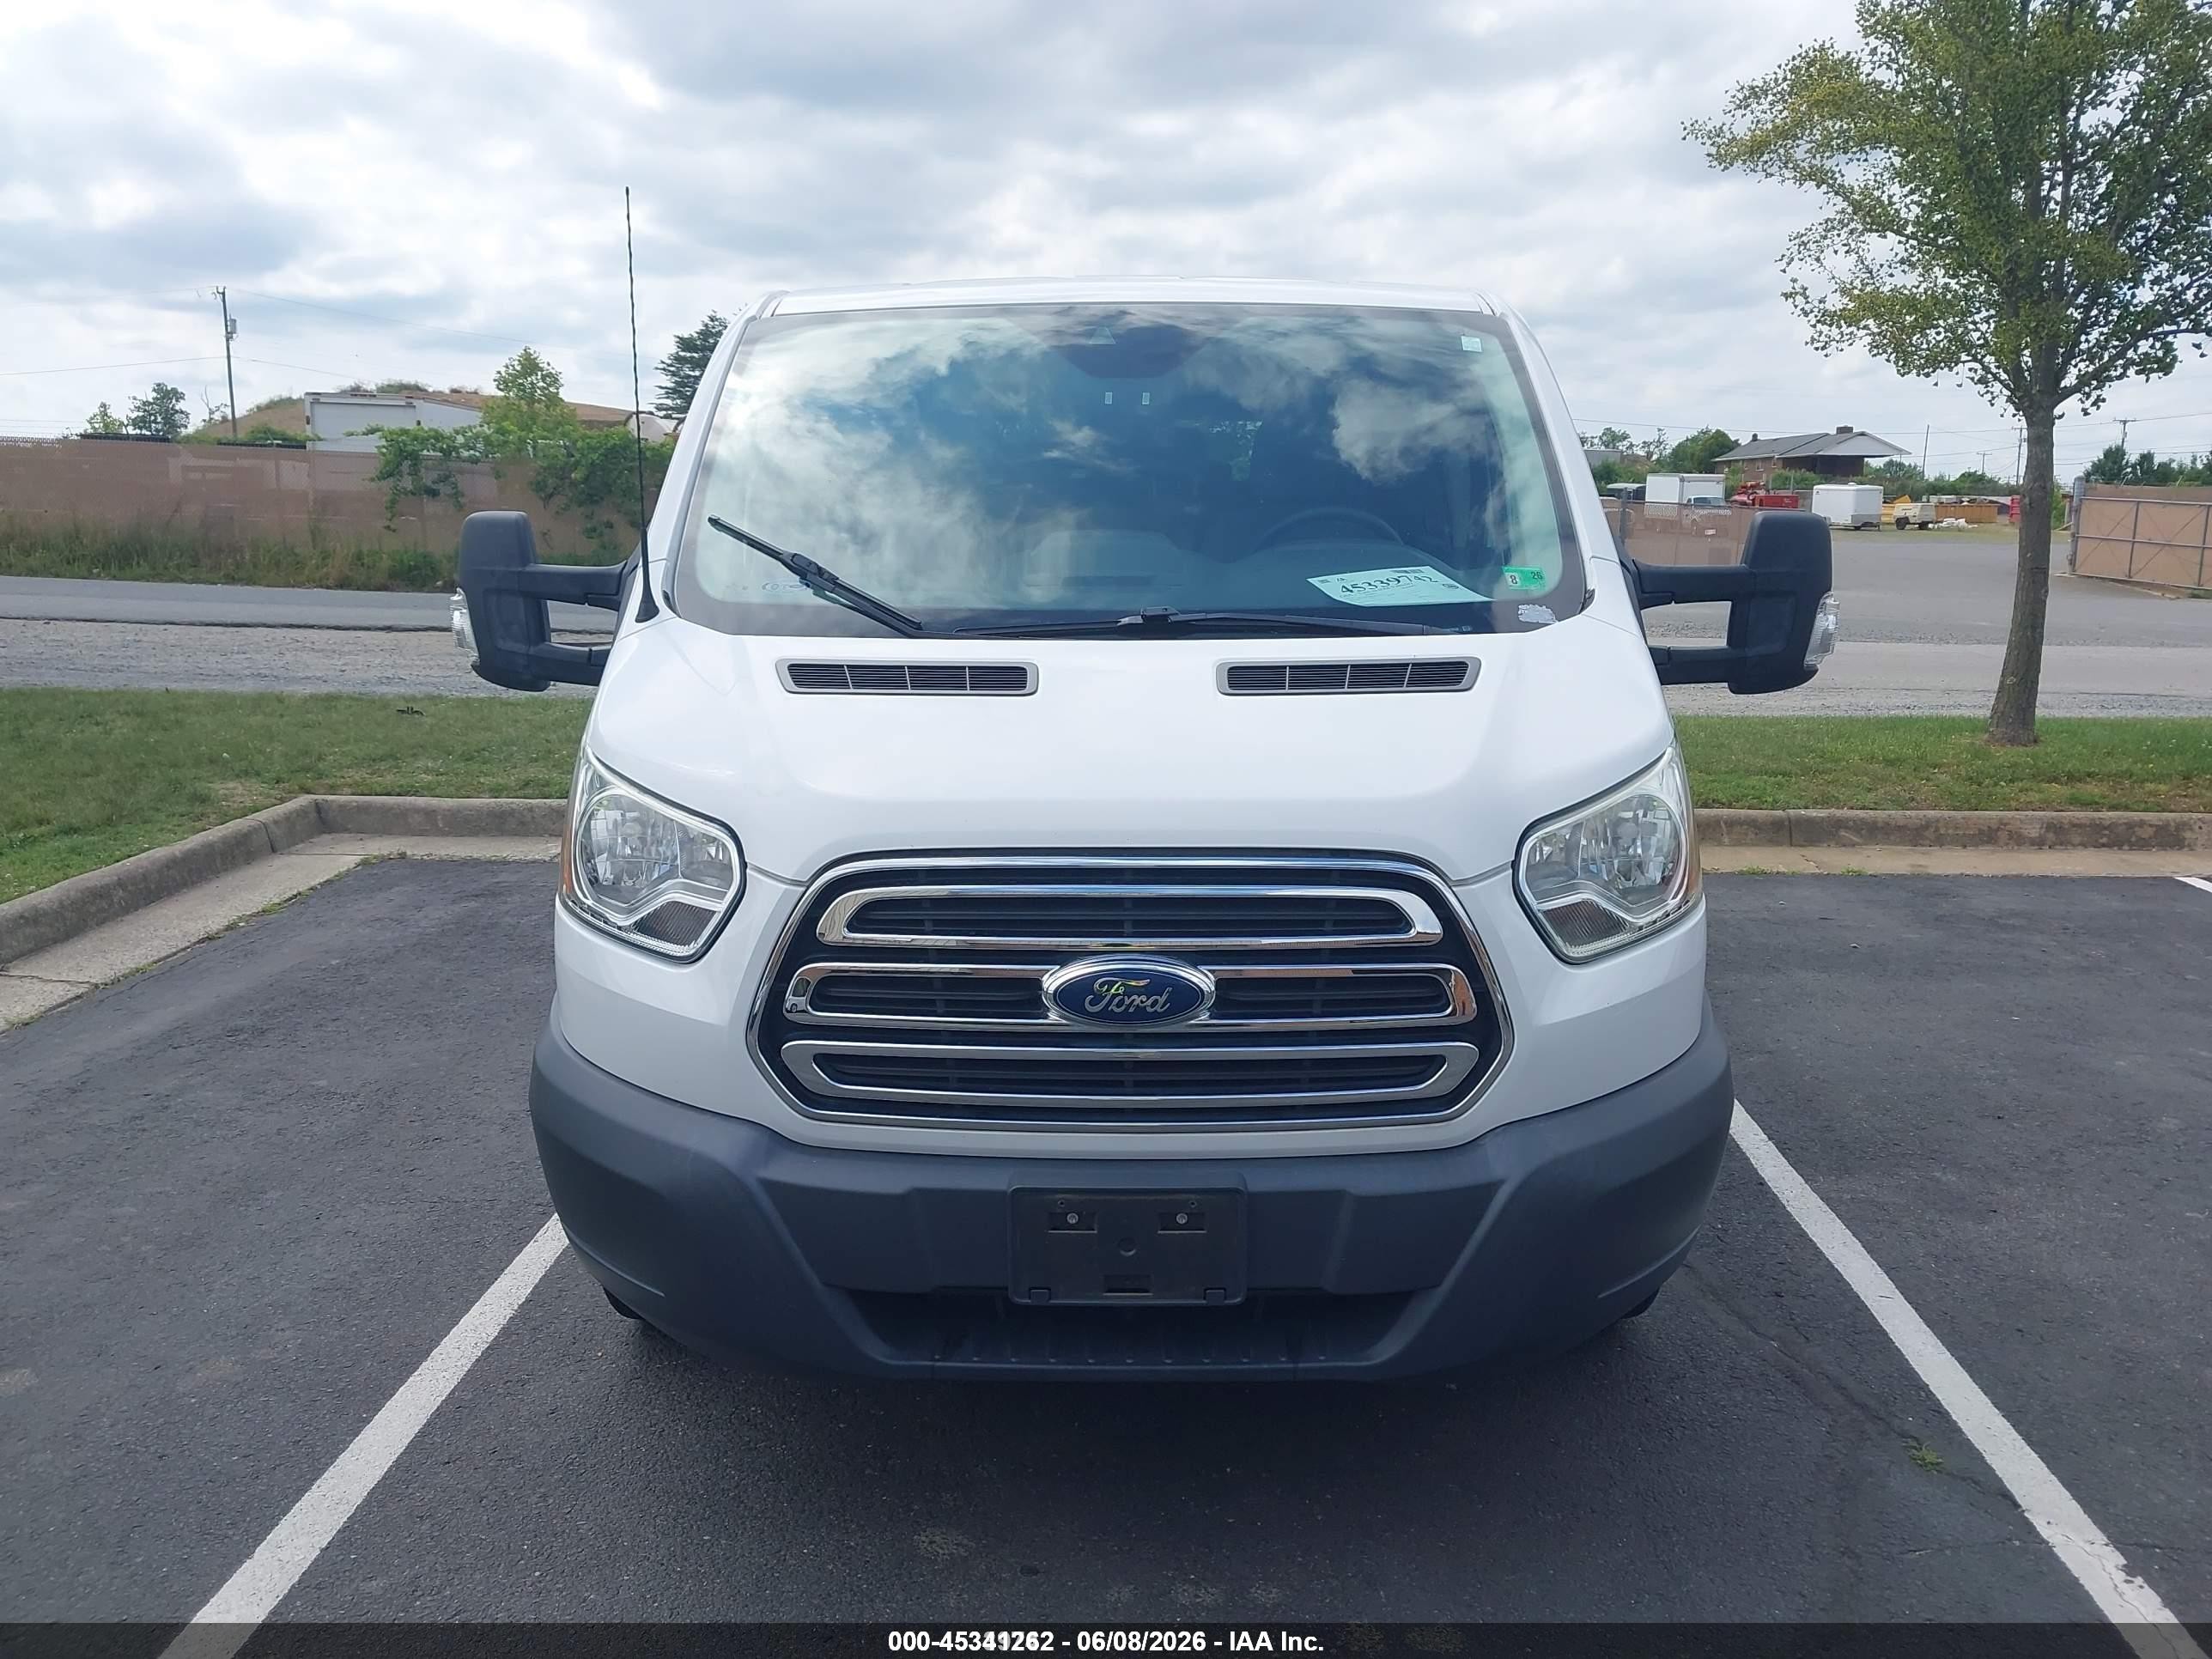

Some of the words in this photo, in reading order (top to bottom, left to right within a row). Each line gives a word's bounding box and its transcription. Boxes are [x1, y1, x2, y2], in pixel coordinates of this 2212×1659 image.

[1510, 574, 1518, 585] 8
[1530, 571, 1543, 580] 26
[1340, 574, 1439, 593] 45339742
[1085, 976, 1172, 1013] Ford
